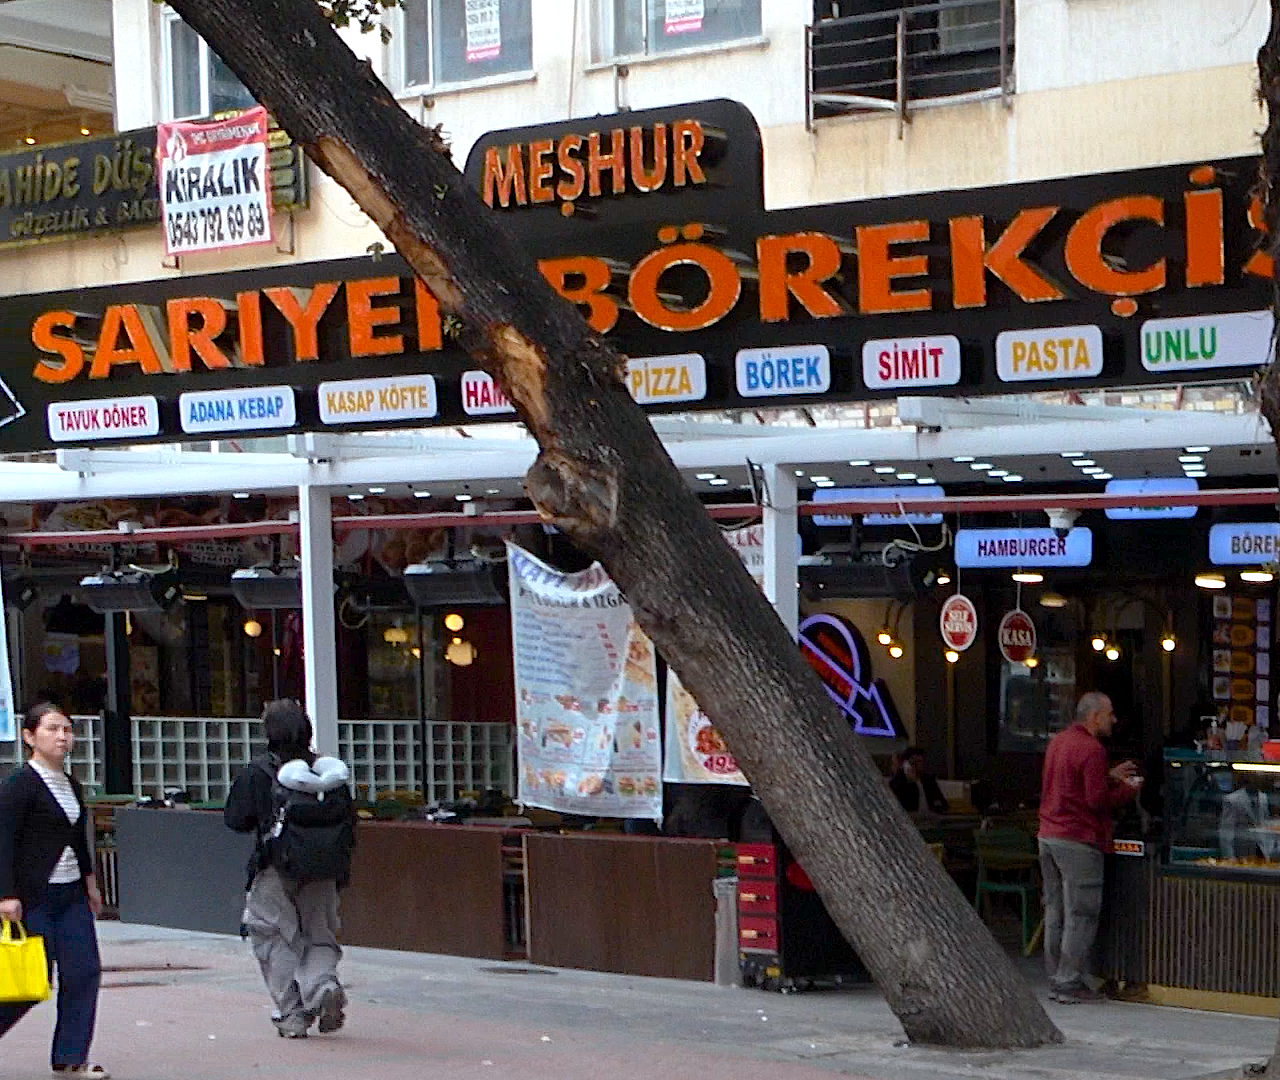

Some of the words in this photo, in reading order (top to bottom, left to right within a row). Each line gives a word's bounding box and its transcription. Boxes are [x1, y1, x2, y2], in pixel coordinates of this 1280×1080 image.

[483, 118, 707, 218] MEŞHUR
[168, 211, 199, 247] 0543
[200, 206, 223, 242] 792
[228, 204, 244, 237] 69
[878, 342, 944, 381] SİMİT
[1012, 338, 1091, 374] PASTA
[1145, 326, 1217, 365] UNLU
[632, 363, 692, 397] PİZZA
[746, 353, 822, 390] BÖREK
[189, 400, 235, 423] ADANA
[238, 396, 284, 419] KEBAP
[326, 391, 374, 415] KASAP
[380, 384, 428, 410] KÖFTE
[58, 410, 100, 432] TAVUK
[103, 403, 148, 428] DÖNER
[977, 536, 1067, 557] HAMBURGER
[1003, 629, 1032, 646] KASA
